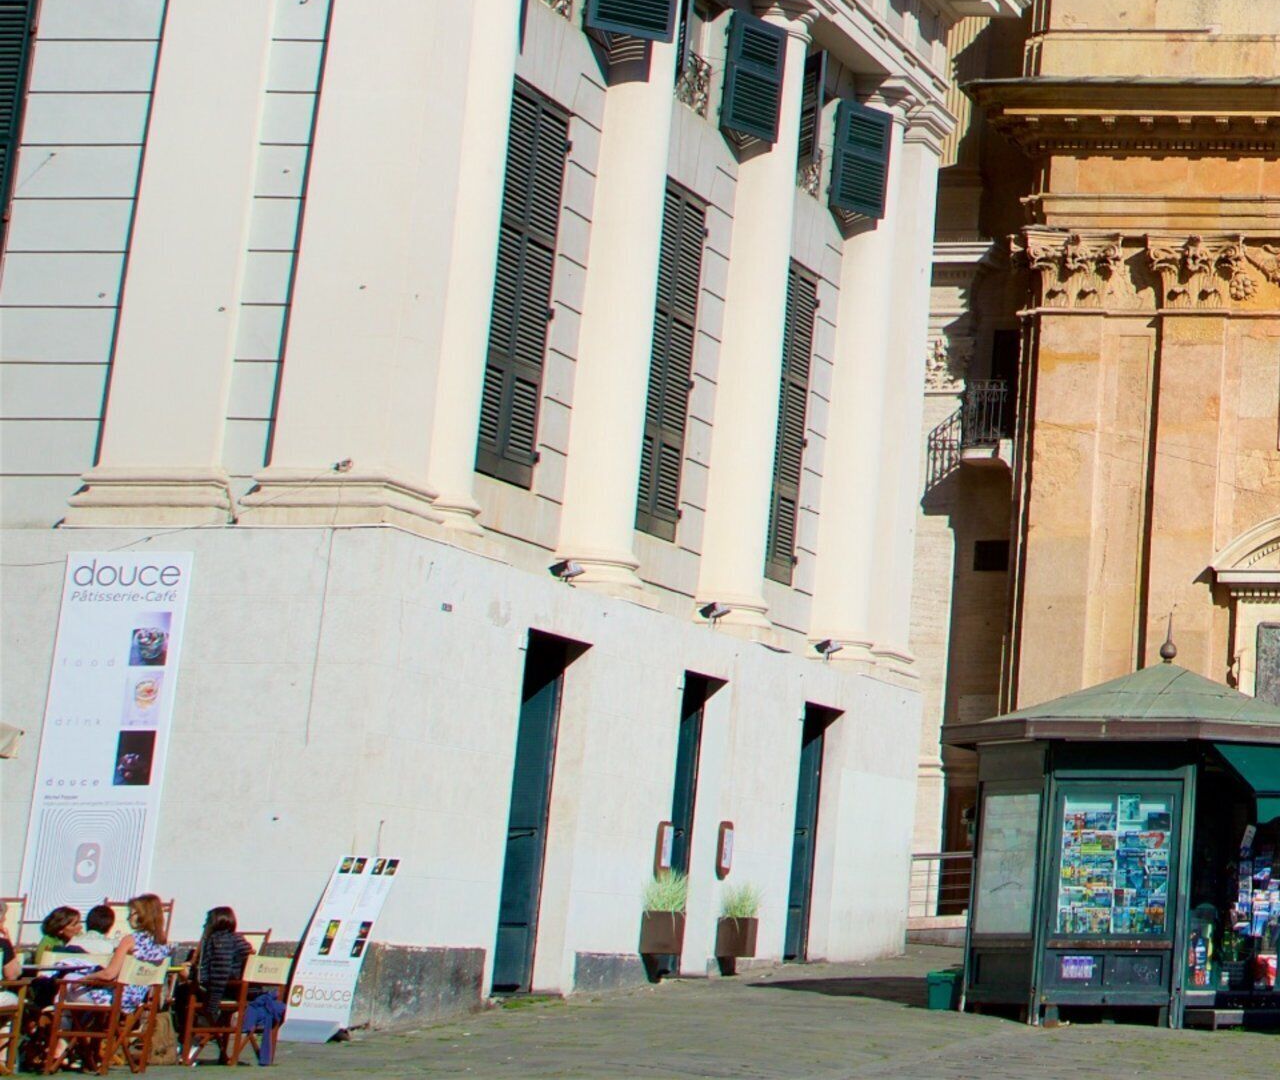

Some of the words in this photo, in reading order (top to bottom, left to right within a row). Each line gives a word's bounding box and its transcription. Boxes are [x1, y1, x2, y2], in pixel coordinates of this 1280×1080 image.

[73, 558, 181, 587] douce
[61, 658, 116, 667] food
[54, 717, 104, 727] drink
[45, 777, 101, 787] douce
[304, 985, 352, 1002] douce
